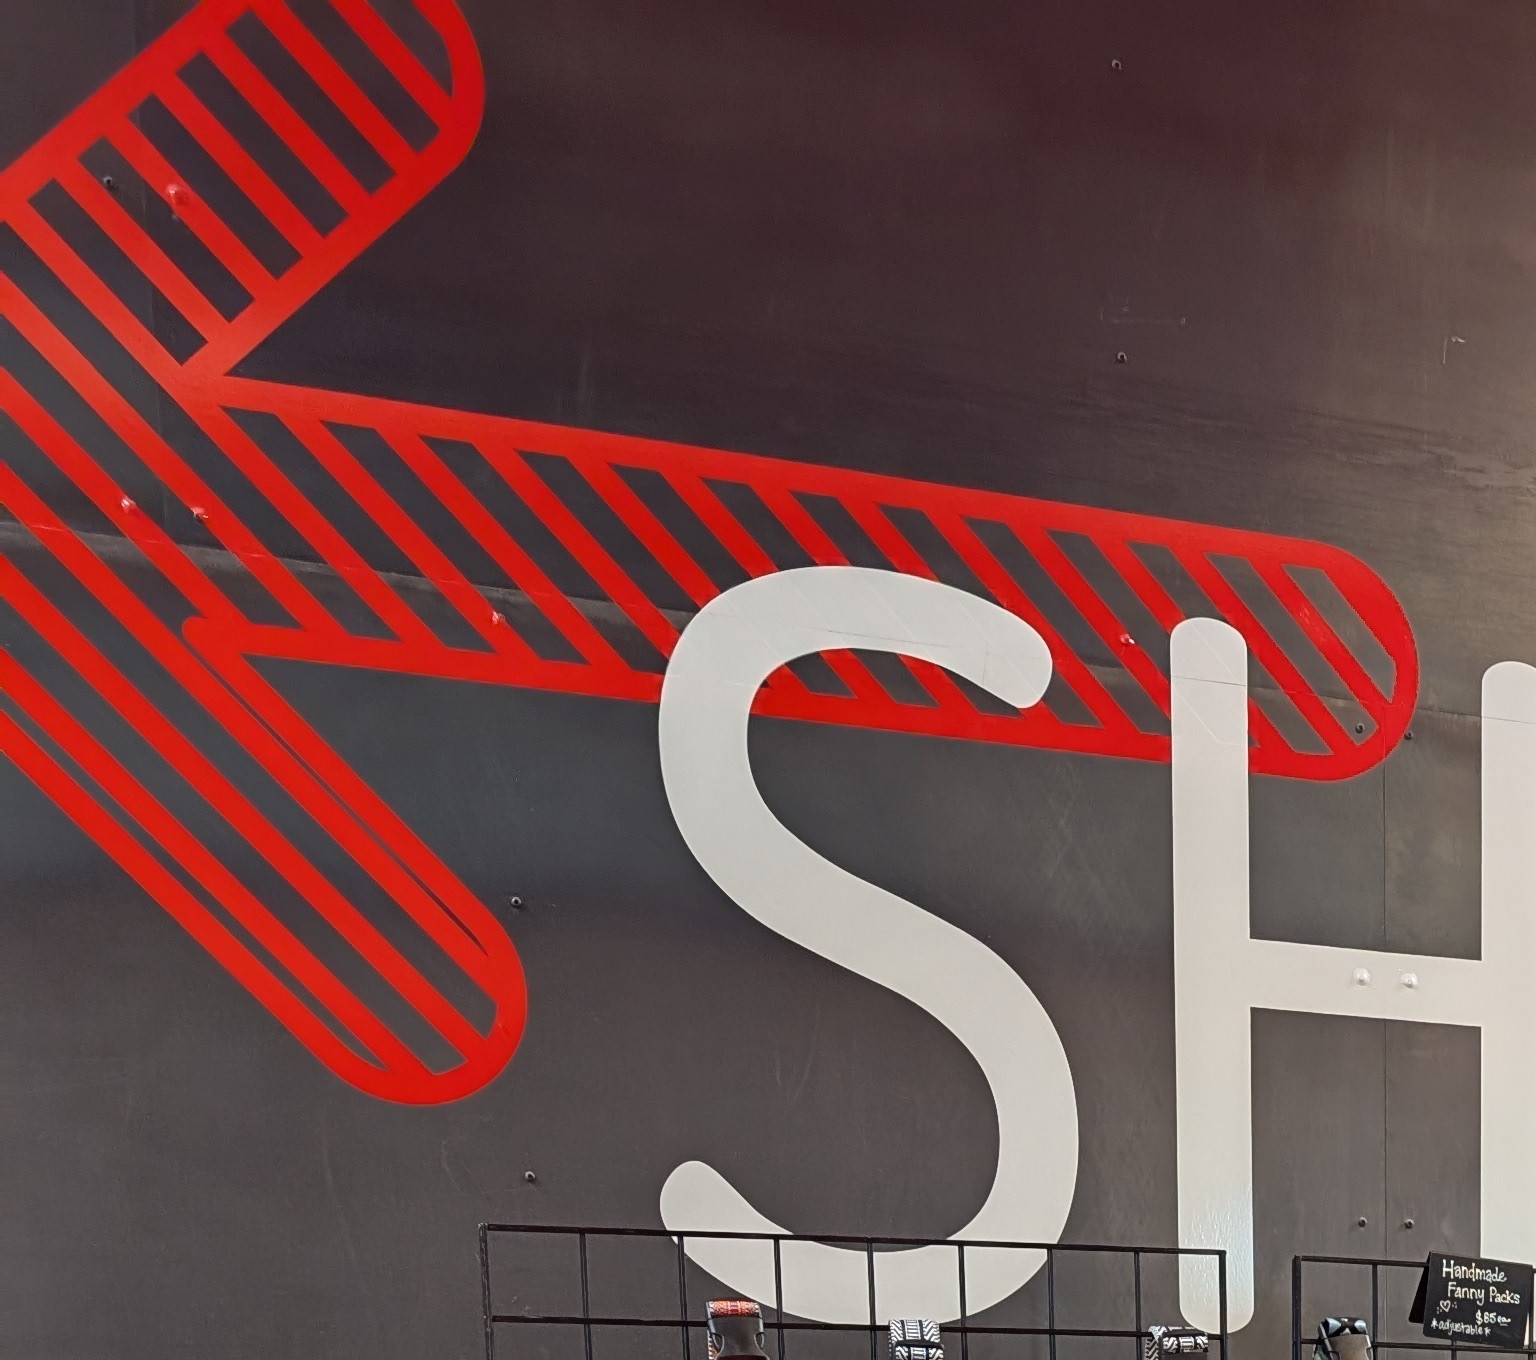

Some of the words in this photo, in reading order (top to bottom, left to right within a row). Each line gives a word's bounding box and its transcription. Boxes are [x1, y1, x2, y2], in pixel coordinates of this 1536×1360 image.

[1442, 1258, 1507, 1283] Handmade
[1447, 1281, 1485, 1306] Fanny
[1489, 1286, 1521, 1305] Packs
